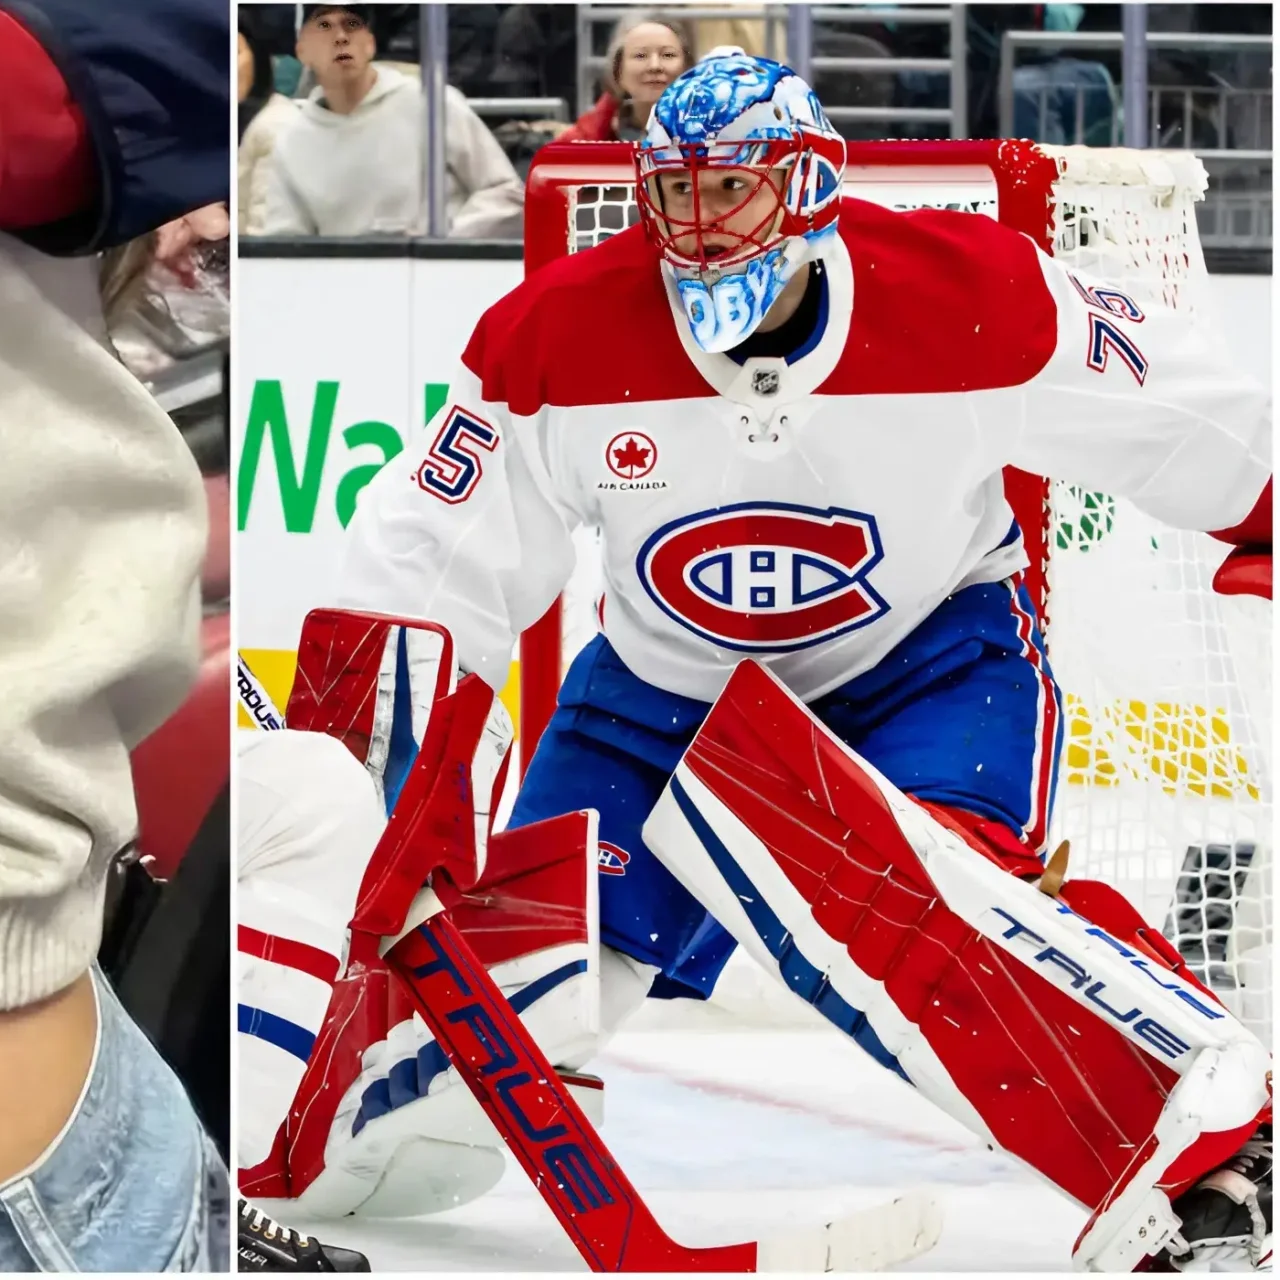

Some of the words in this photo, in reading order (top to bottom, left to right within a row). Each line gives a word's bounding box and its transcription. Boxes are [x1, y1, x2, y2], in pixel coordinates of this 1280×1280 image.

[1065, 269, 1149, 388] 75
[991, 906, 1192, 1060] TRUE
[414, 923, 615, 1214] TRUE
